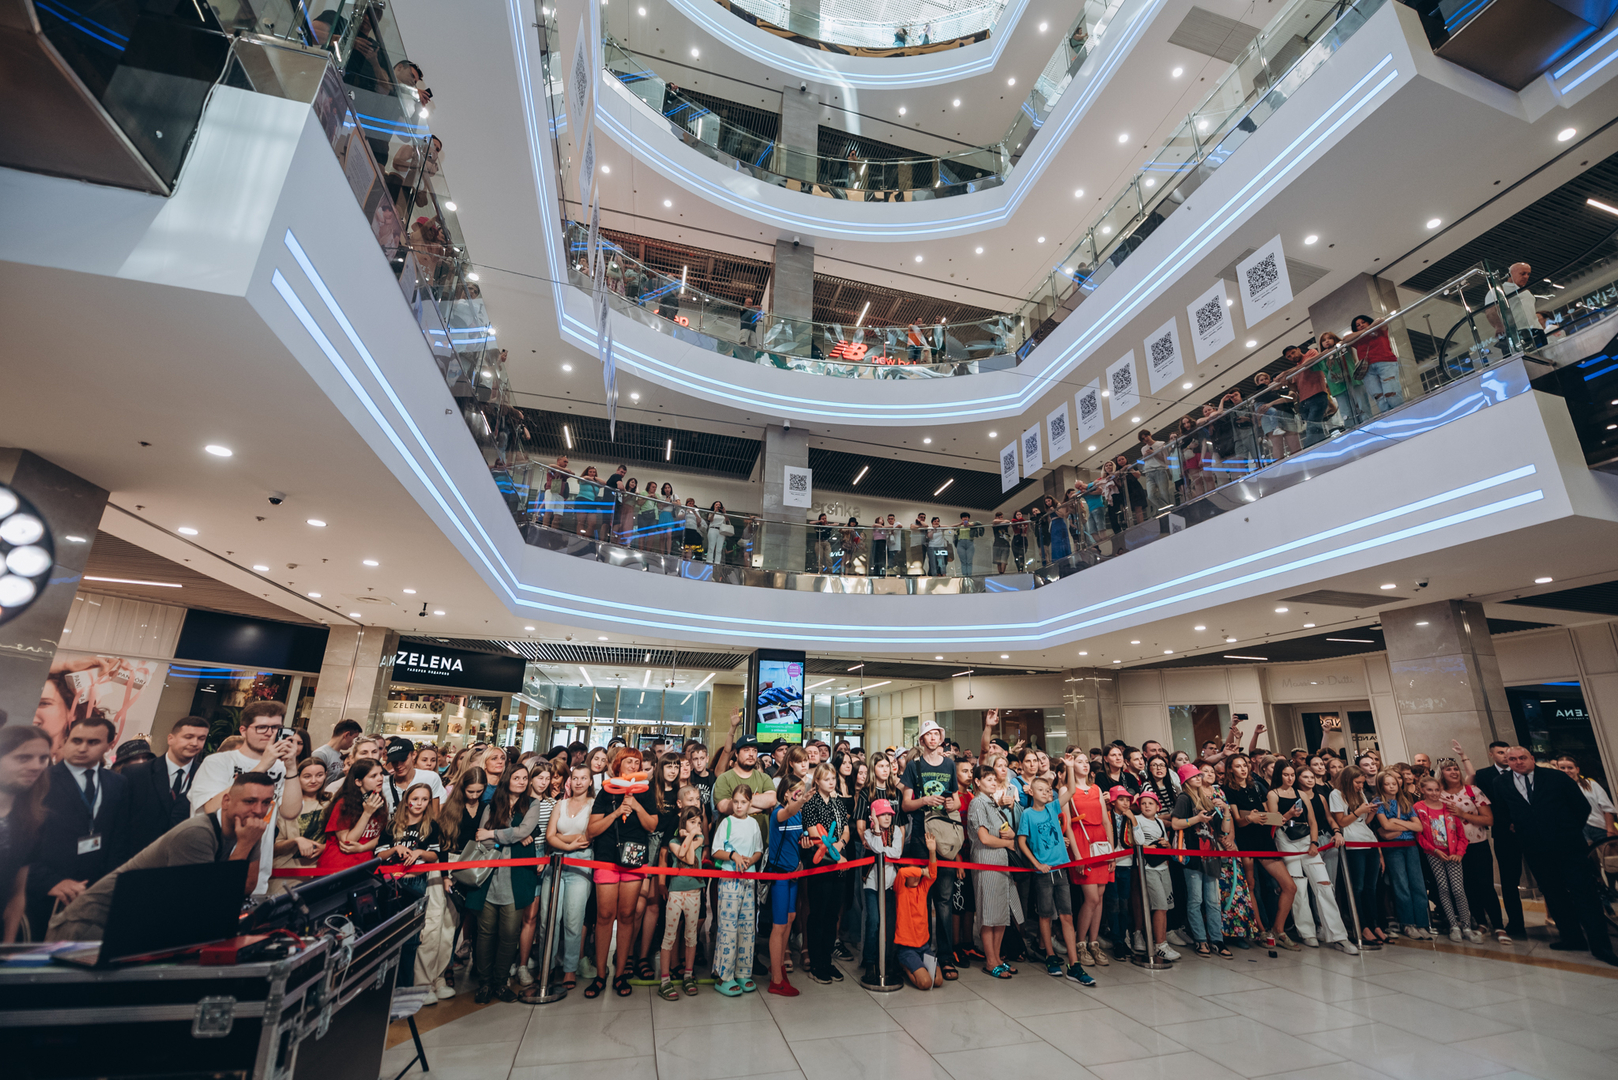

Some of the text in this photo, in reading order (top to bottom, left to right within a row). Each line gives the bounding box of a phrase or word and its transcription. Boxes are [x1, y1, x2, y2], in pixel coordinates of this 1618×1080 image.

[810, 501, 860, 518] ershka
[396, 651, 463, 672] ZELENA
[118, 671, 146, 685] PANOR
[1282, 677, 1324, 688] Massio
